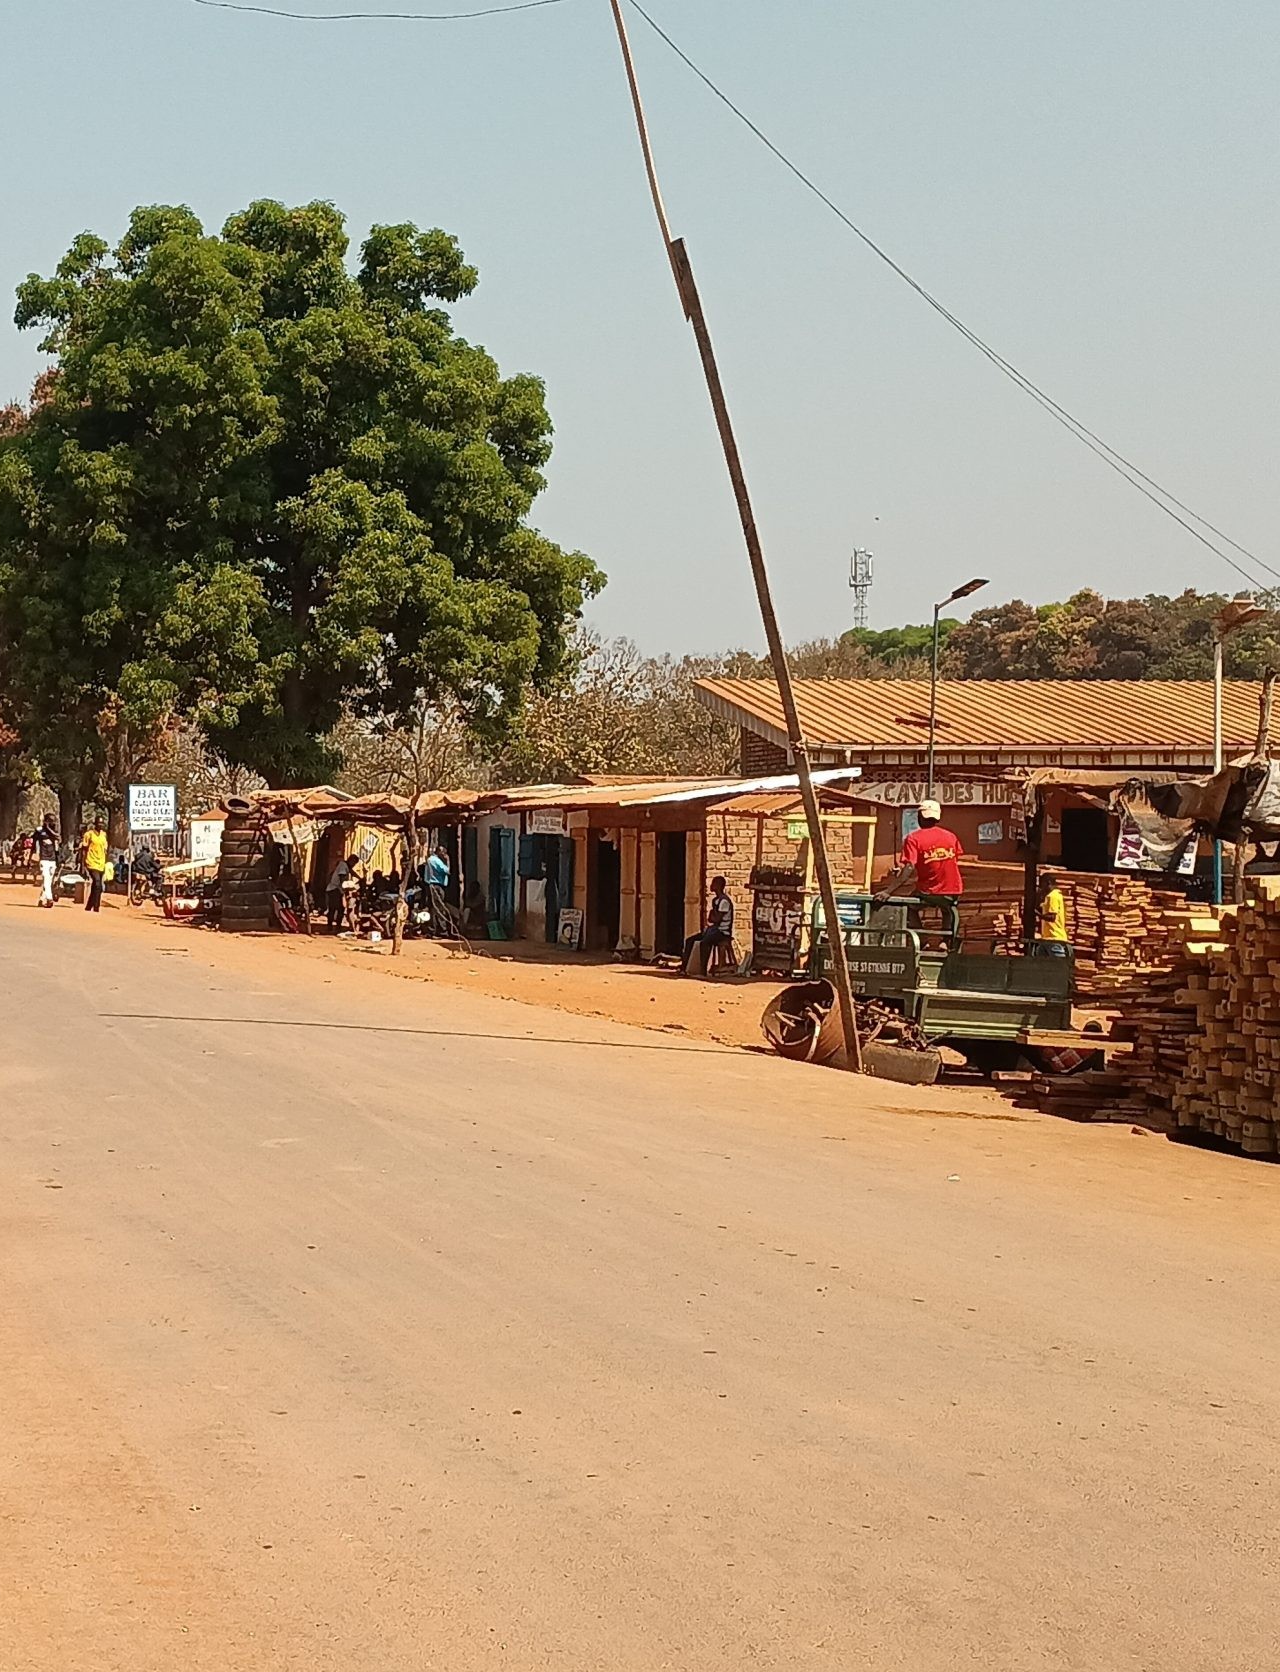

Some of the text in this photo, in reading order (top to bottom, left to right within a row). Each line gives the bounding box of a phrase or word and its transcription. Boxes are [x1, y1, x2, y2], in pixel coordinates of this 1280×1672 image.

[137, 789, 168, 798] BAR
[884, 783, 936, 803] CAVE
[942, 783, 974, 803] DES
[891, 962, 906, 974] BTP
